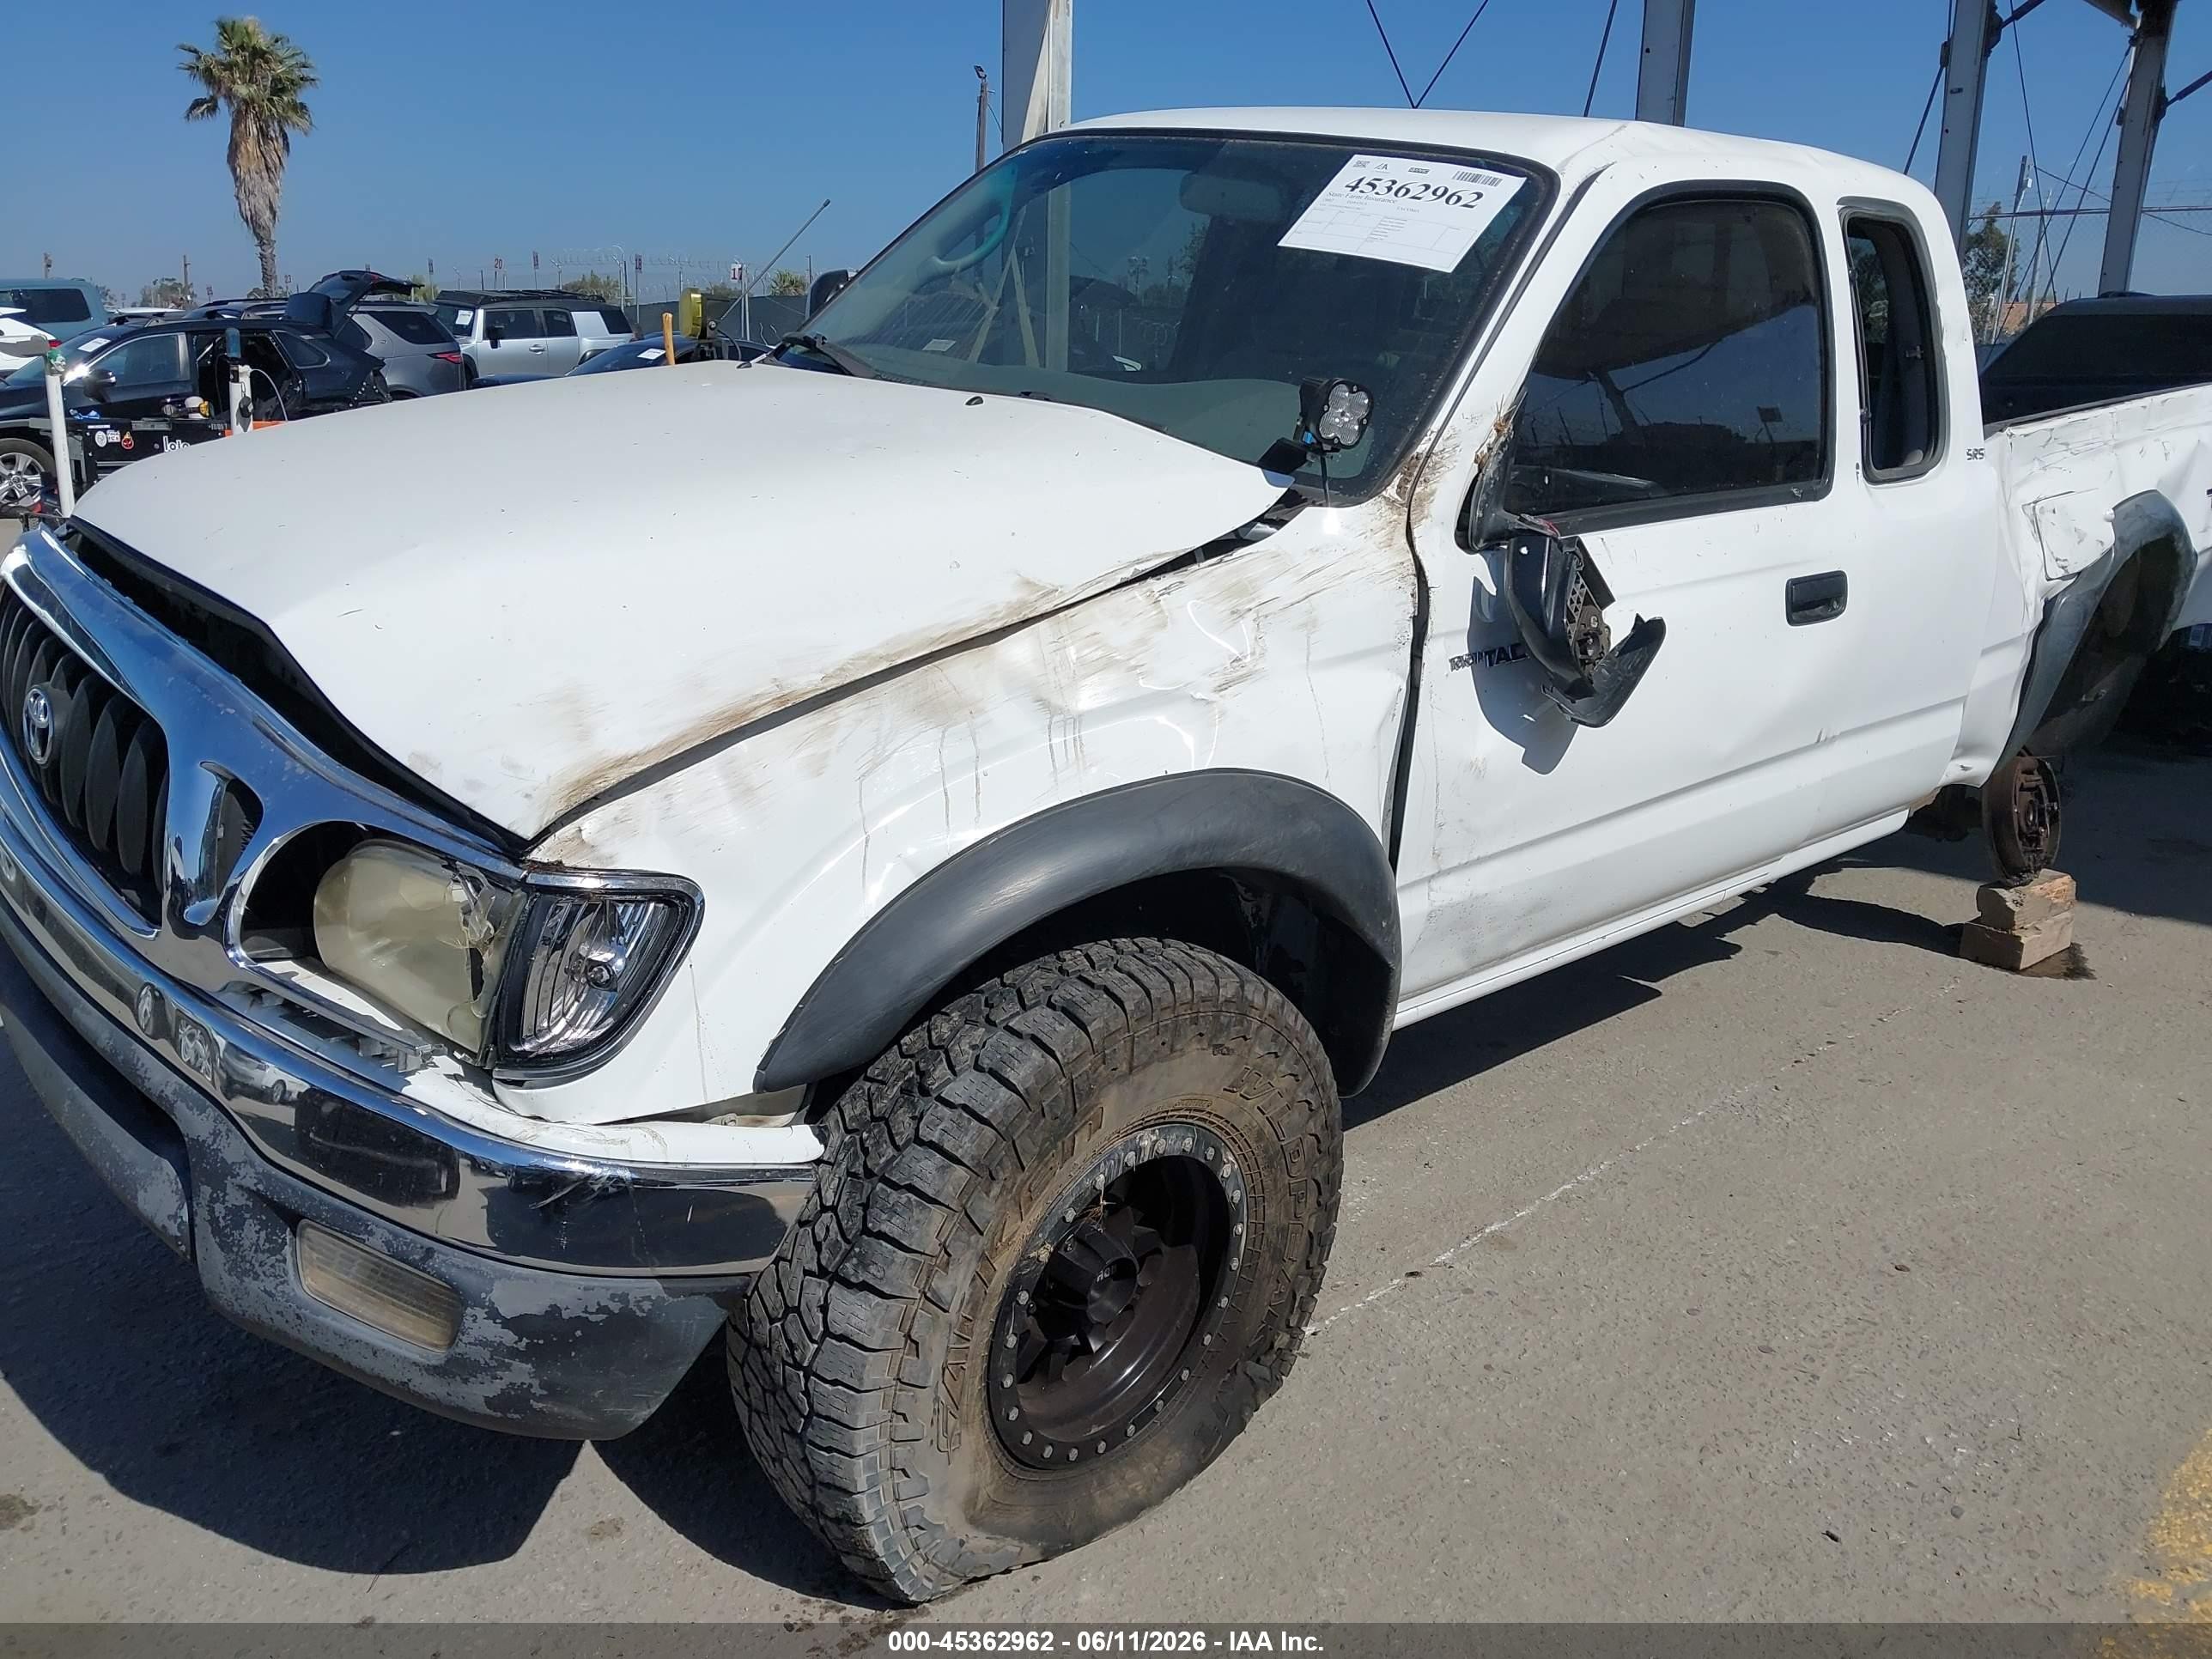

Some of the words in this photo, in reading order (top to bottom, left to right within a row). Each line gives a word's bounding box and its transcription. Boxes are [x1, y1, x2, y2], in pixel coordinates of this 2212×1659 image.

[1345, 176, 1484, 209] 45362962
[1363, 194, 1398, 204] Insurance
[494, 258, 503, 270] 20
[1484, 642, 1528, 668] TAC
